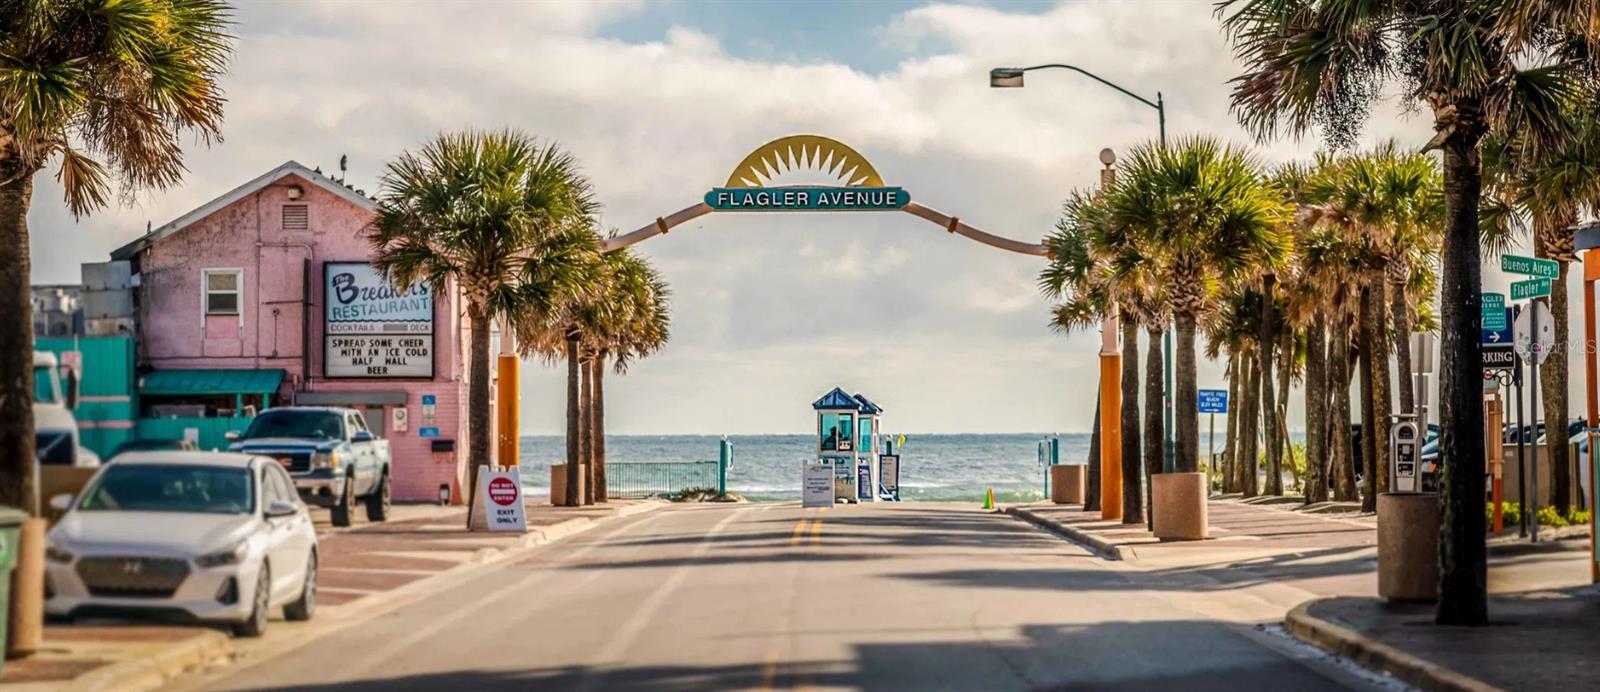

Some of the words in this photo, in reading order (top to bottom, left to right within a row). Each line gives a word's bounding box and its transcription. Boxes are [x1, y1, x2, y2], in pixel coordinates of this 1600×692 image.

[718, 192, 809, 206] FLAGLER
[817, 192, 896, 205] AVENUE
[1503, 258, 1529, 272] Buenos
[1533, 262, 1551, 276] Aires
[332, 273, 428, 304] Breakrs
[1514, 283, 1538, 297] Flagler
[333, 297, 428, 319] RESTAURANT
[332, 339, 366, 348] SPREAD
[370, 339, 392, 347] SOME
[341, 348, 362, 357] WITH
[1482, 351, 1512, 362] RKING
[352, 357, 373, 365] HALF
